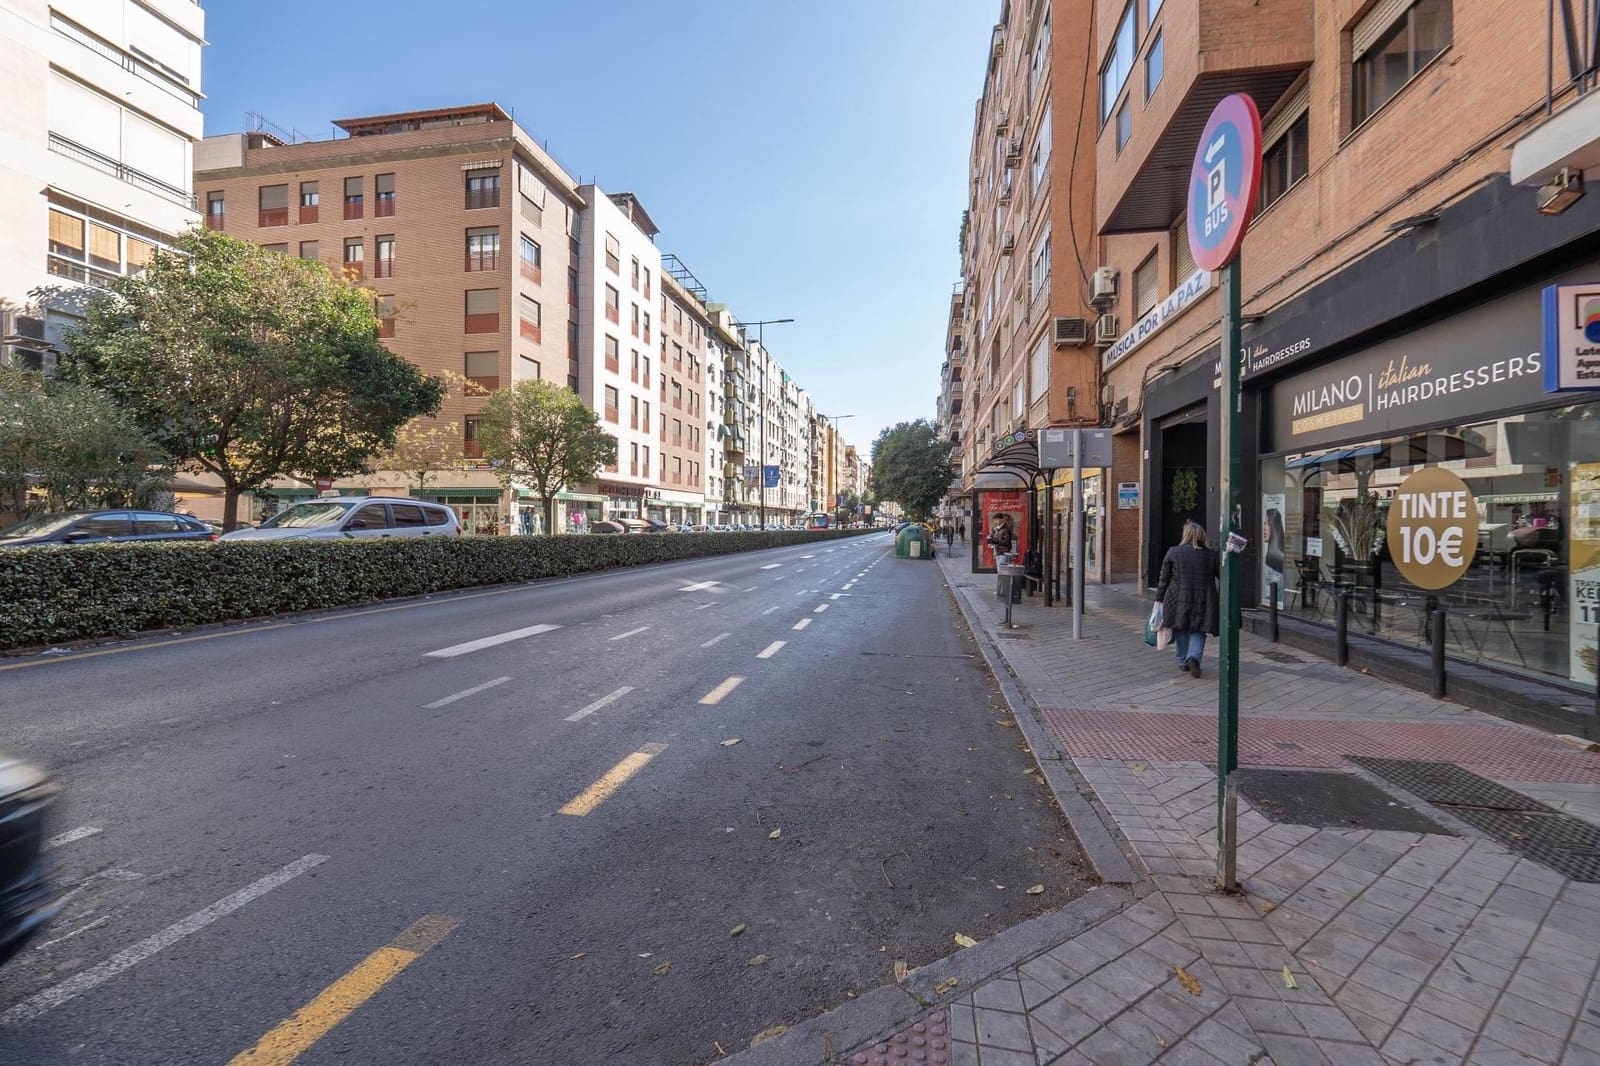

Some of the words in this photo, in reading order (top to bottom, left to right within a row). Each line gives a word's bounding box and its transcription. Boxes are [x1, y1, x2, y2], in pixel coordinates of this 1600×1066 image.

[1211, 169, 1221, 206] P
[1204, 200, 1229, 238] BUS
[1138, 313, 1158, 340] POR
[1161, 299, 1175, 321] LA
[1177, 272, 1203, 306] PAZ
[1252, 337, 1311, 373] HAIRDRESSERS
[1378, 355, 1432, 390] italian
[1293, 375, 1362, 416] MILANO
[1377, 352, 1541, 411] HAIRDRESSERS
[1295, 407, 1360, 431] COSMETICS
[1398, 491, 1466, 519] TINTE
[1400, 526, 1463, 567] 10€
